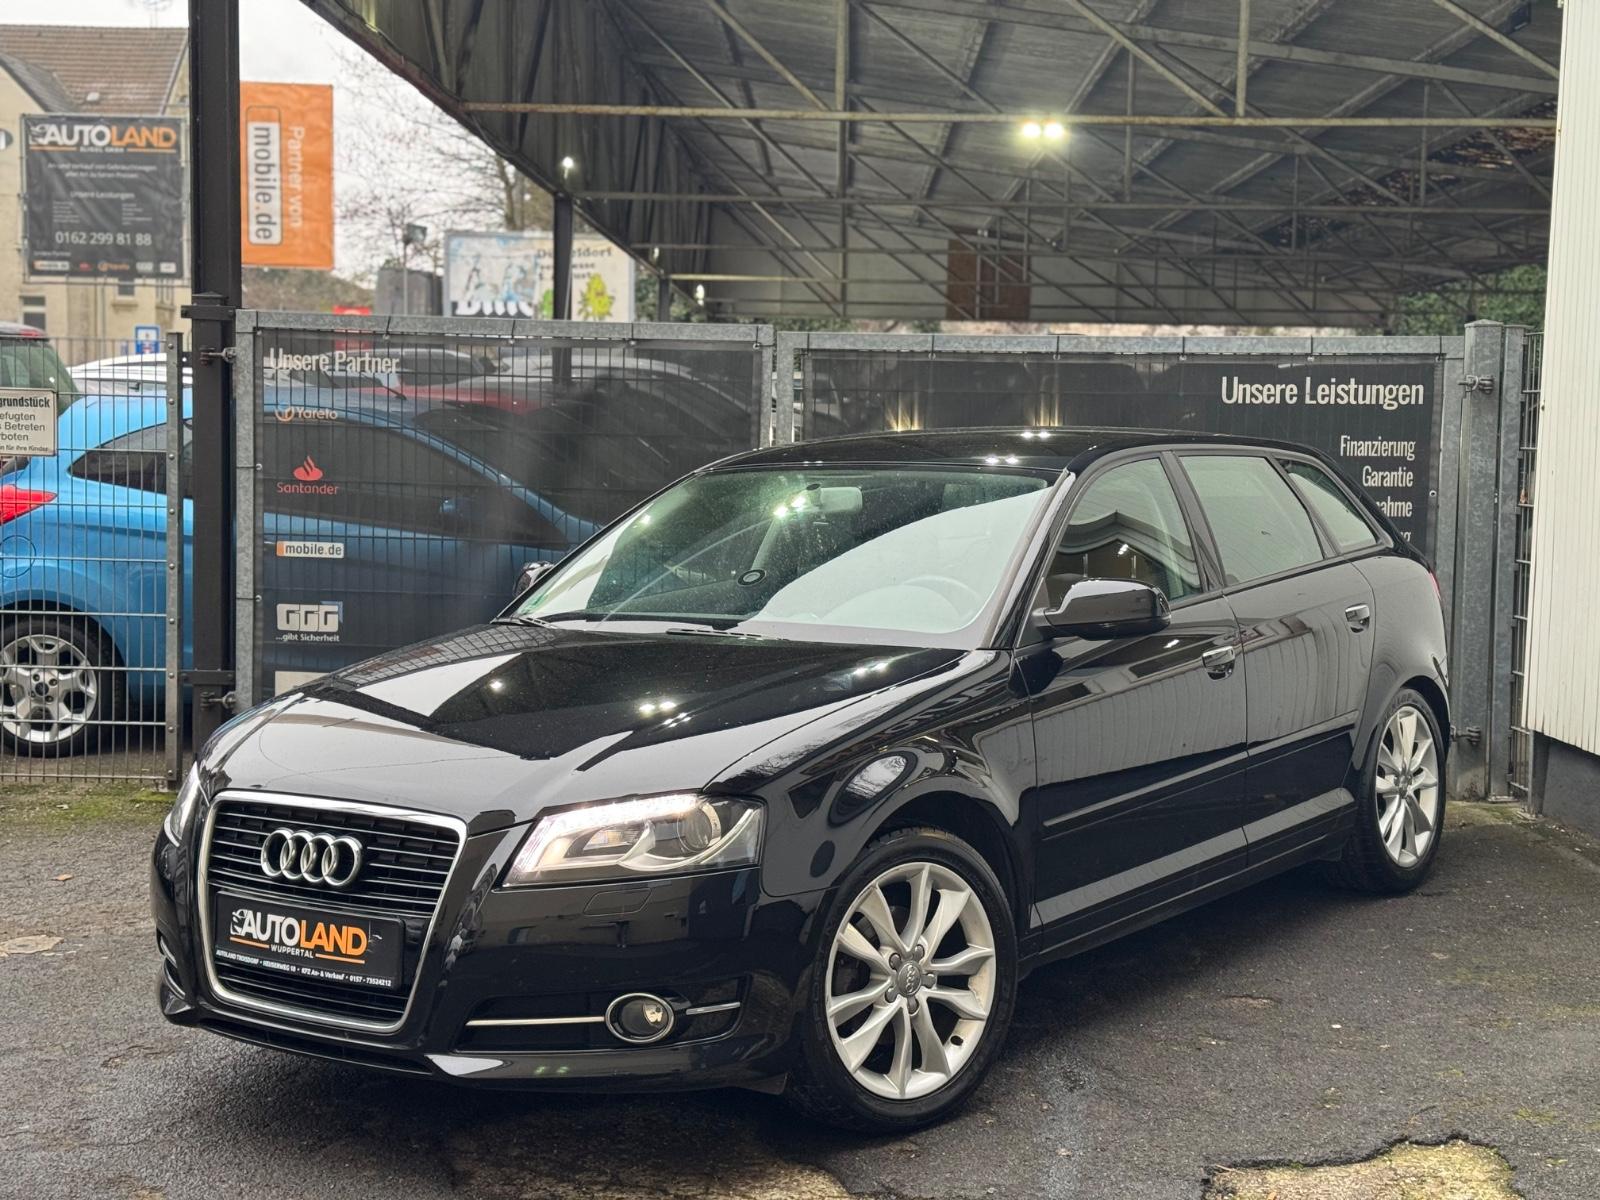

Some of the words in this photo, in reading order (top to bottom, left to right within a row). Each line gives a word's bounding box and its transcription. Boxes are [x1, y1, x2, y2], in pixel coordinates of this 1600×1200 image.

[44, 123, 177, 147] AUTOLAND
[288, 126, 305, 191] Partner
[254, 127, 277, 240] mobile.de
[288, 195, 303, 228] von
[55, 231, 87, 244] 0162
[90, 232, 113, 245] 299
[116, 233, 131, 245] 81
[136, 233, 152, 246] 88
[269, 347, 329, 372] Unsere
[335, 350, 400, 374] Partner
[1221, 376, 1298, 405] Unsere
[1304, 376, 1424, 411] Leistungen
[295, 406, 338, 420] Yareto
[4, 422, 46, 431] Betreten
[1340, 435, 1416, 461] Finanzierung
[1362, 465, 1414, 488] Garantie
[276, 482, 340, 495] Santander
[285, 544, 342, 556] mobile.de
[300, 633, 340, 643] Sicherheit
[240, 909, 368, 957] AUTOLAND
[270, 943, 314, 960] WUPPERTAL
[325, 970, 345, 981] Verkauf
